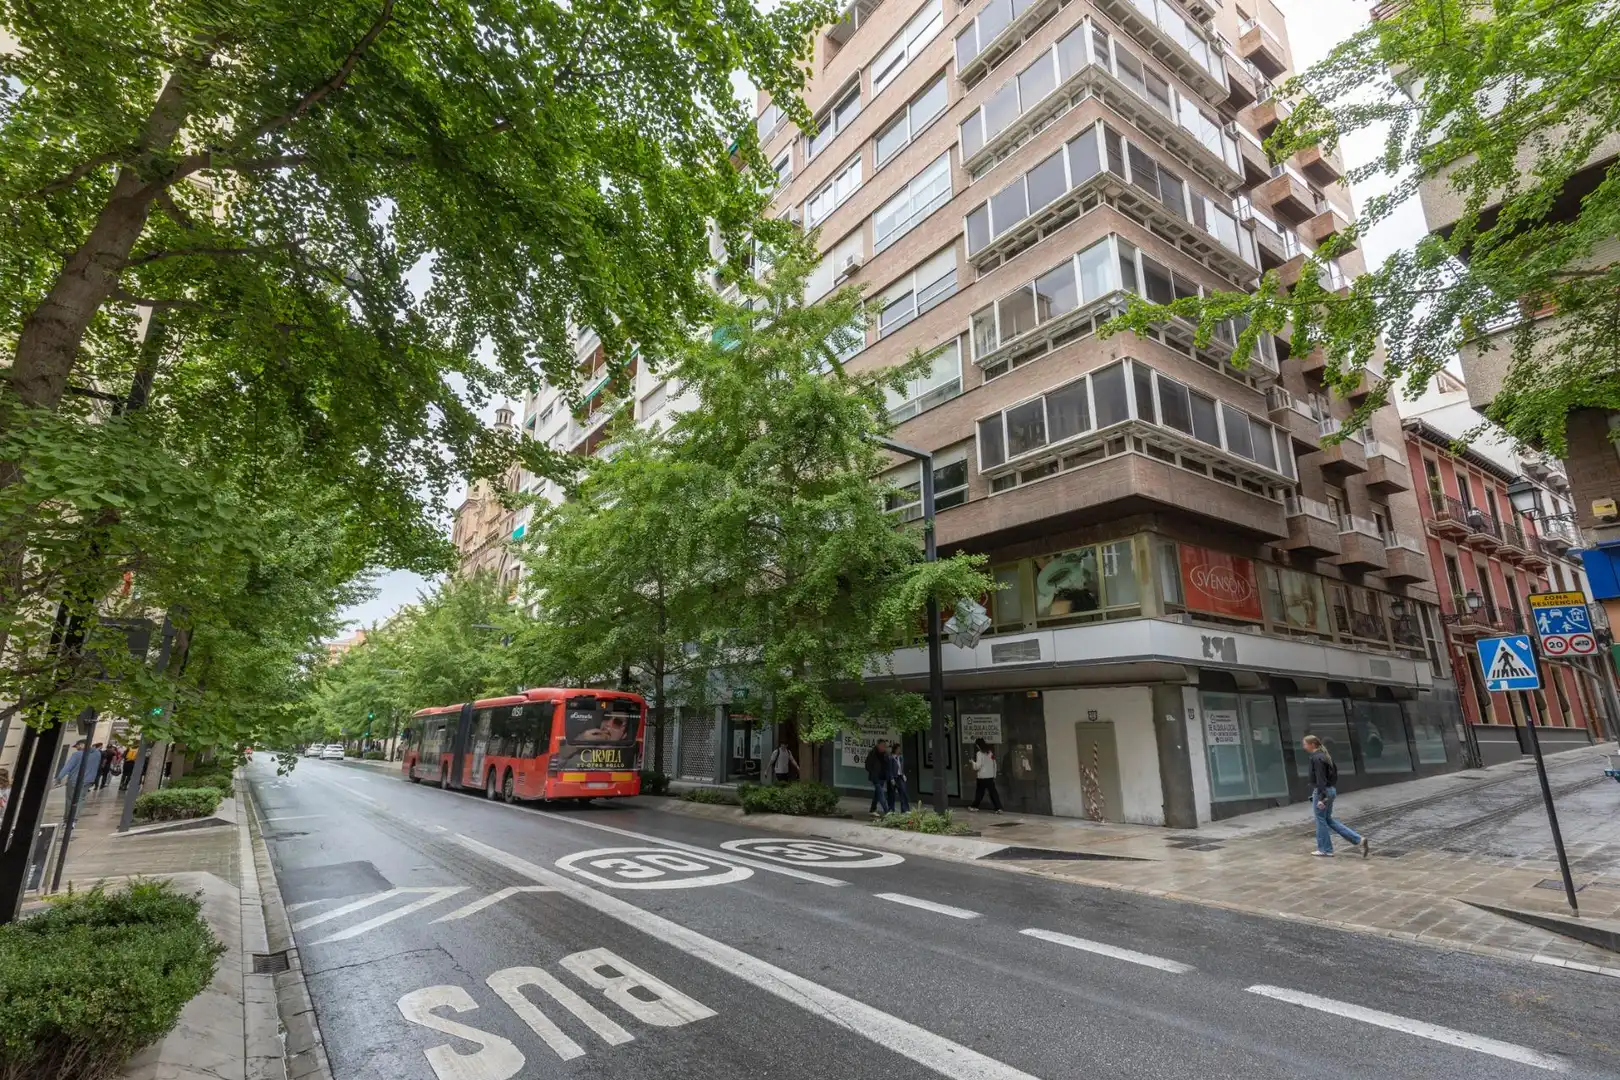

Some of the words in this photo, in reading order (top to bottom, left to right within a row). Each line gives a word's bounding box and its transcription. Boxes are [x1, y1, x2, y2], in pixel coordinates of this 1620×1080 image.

[1197, 570, 1245, 594] SVENSON
[1532, 599, 1584, 607] RESIDENCIAL
[1548, 641, 1563, 649] 20
[844, 736, 851, 746] SE
[580, 749, 622, 763] CARMELA
[754, 843, 863, 860] 30
[590, 854, 710, 878] 30
[397, 947, 719, 1080] BUS
